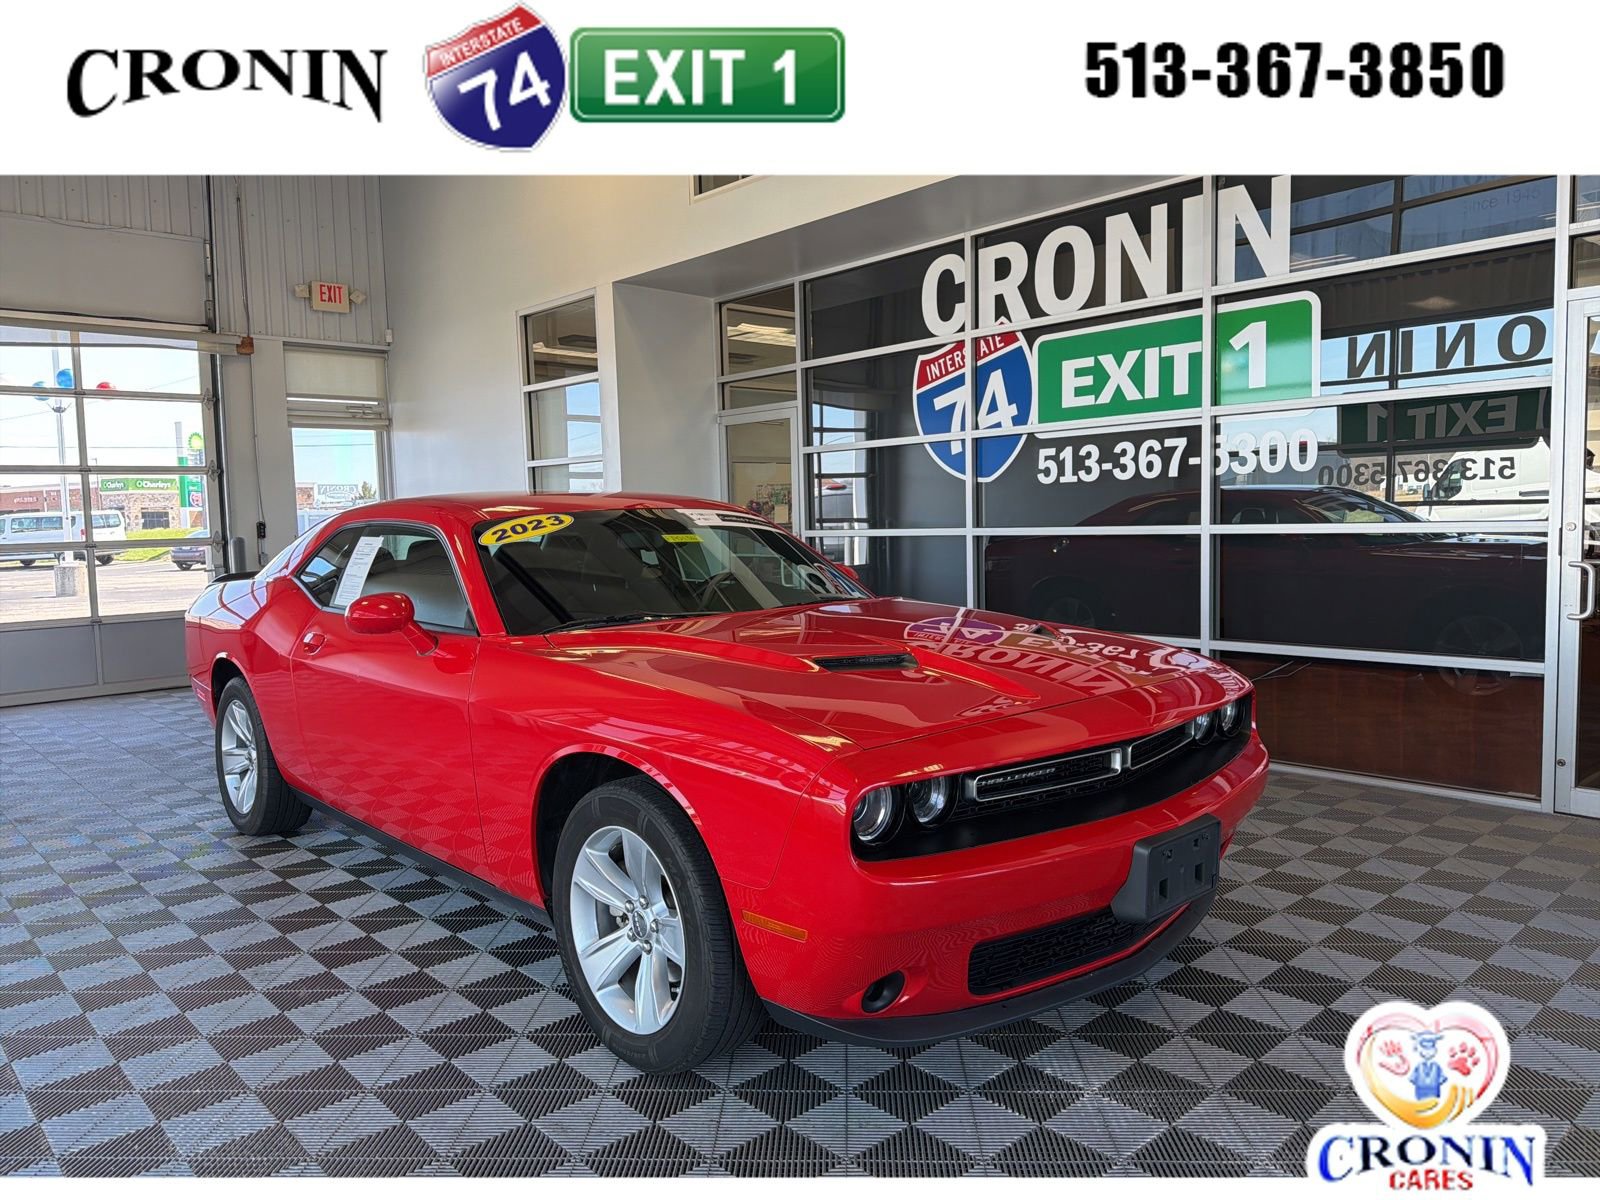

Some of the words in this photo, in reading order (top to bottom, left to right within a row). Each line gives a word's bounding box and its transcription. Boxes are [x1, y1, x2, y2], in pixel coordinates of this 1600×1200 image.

[921, 174, 1291, 337] CRONIN
[319, 284, 343, 305] EXIT
[926, 334, 1005, 382] INTERATE
[1061, 341, 1202, 409] EXIT
[1228, 321, 1267, 389] 1
[933, 368, 1019, 456] 74
[1037, 428, 1319, 485] 513-367-5300
[491, 515, 565, 543] 2023
